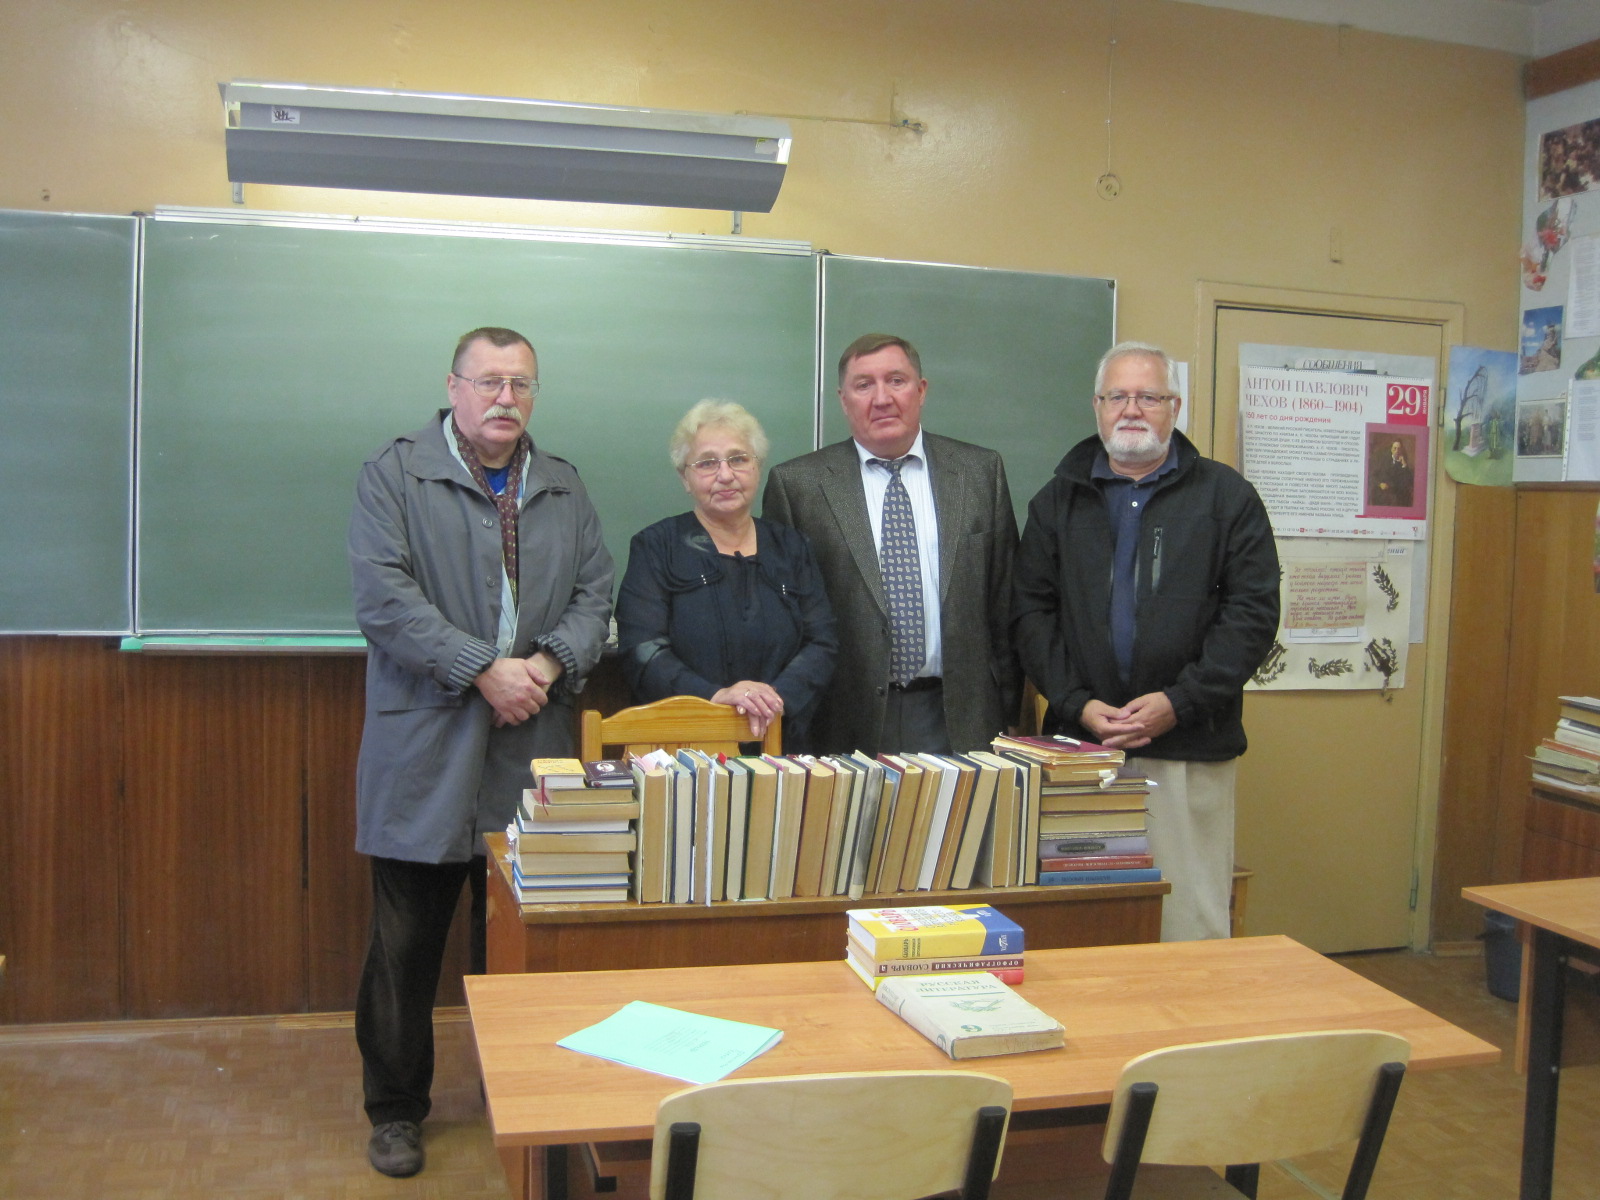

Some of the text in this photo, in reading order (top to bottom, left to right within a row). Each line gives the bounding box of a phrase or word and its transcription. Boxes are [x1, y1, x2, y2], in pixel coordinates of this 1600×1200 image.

[1246, 377, 1368, 397] АНТОН ПАВЛОВИЧ
[1246, 394, 1288, 409] ЧЕХОВ
[1388, 385, 1420, 416] 29
[1294, 416, 1331, 424] рождения
[891, 960, 1019, 972] ОРФОГРАФИЧЕСКИЙ СЛОВАРЬ
[916, 984, 997, 992] ЛИТЕРАТУРА
